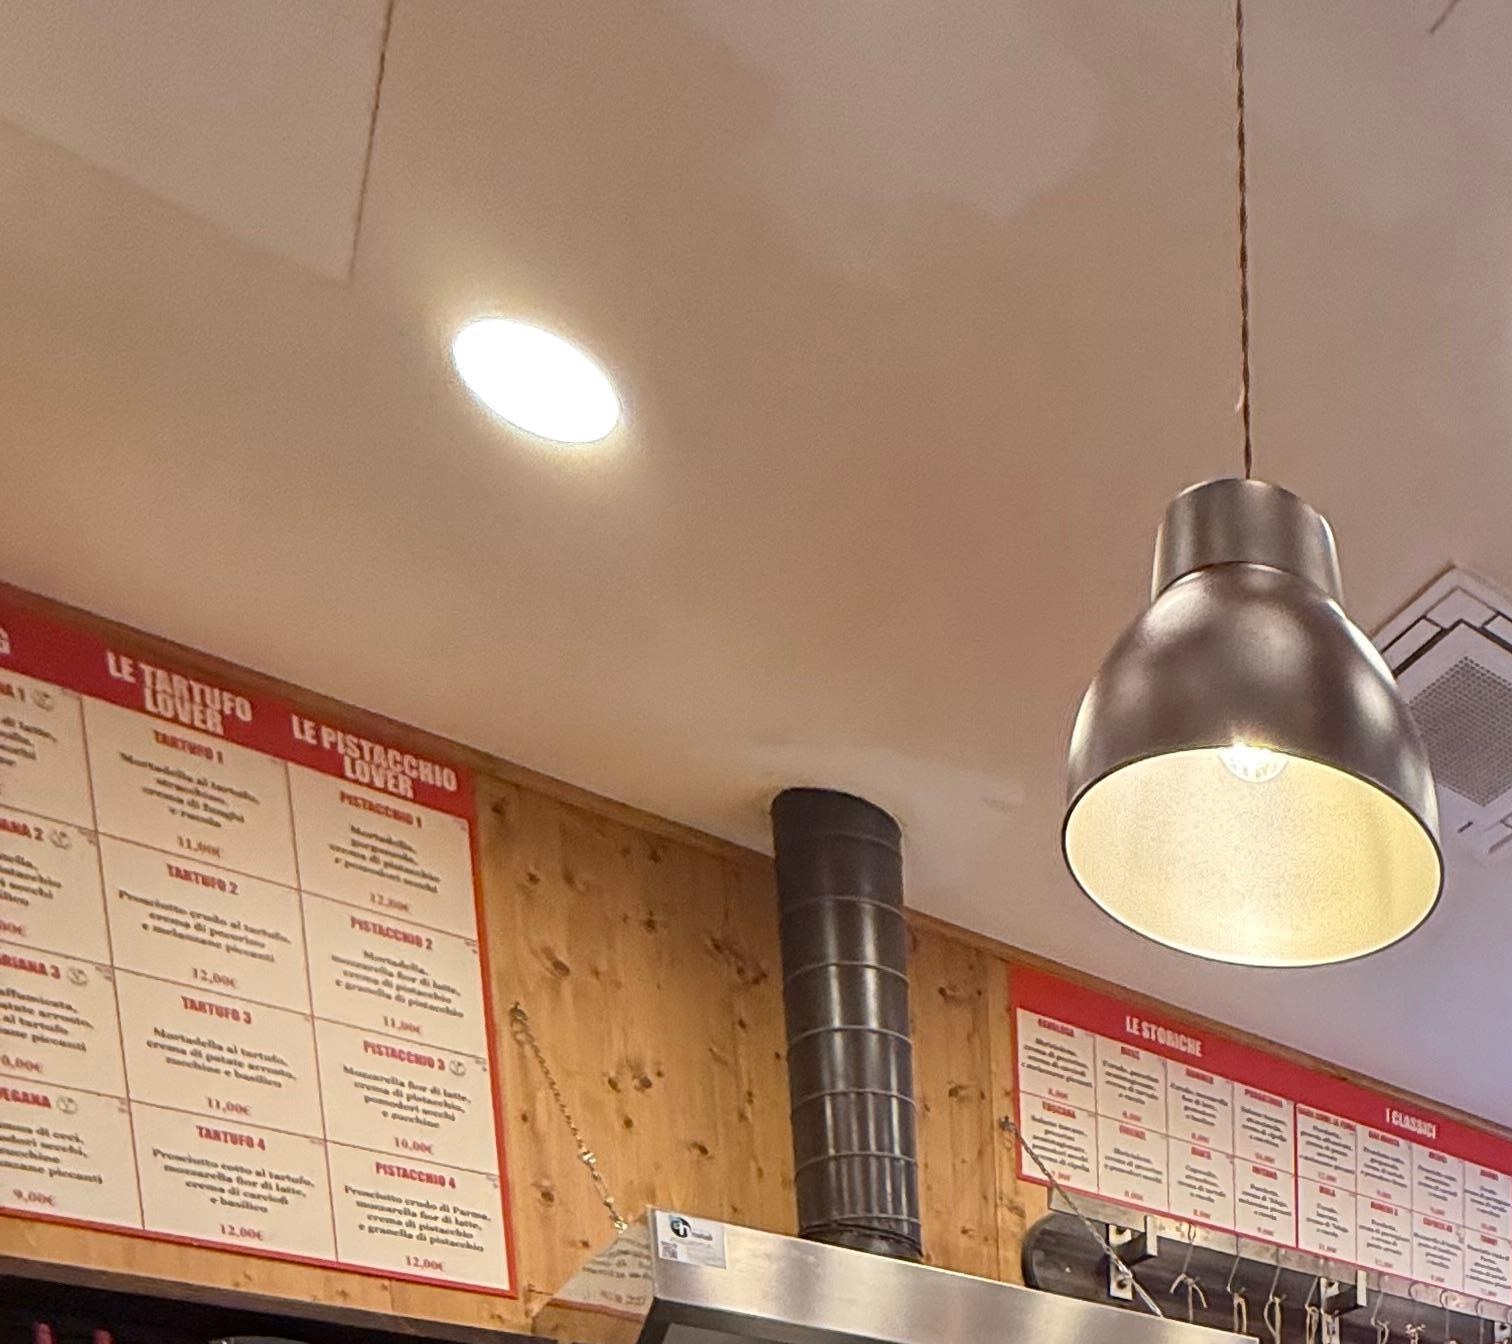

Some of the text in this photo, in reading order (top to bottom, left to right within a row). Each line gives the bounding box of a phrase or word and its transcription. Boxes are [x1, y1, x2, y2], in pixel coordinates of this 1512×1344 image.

[107, 651, 252, 722] LE TARTUFO
[145, 687, 224, 736] LOVER
[292, 714, 457, 791] LE PISTACCHIO
[344, 755, 414, 799] LOVER
[166, 863, 239, 895] TARTUFO 2
[350, 916, 433, 950] PISTACCHIO 2
[181, 996, 252, 1024] TARTUFO 3
[1125, 1015, 1203, 1057] LE STORICHE
[364, 1040, 445, 1071] PISTACCHIO 3
[196, 1125, 266, 1151] TARTUFO 4
[1391, 1110, 1437, 1139] CLASSICI
[376, 1161, 456, 1189] PISTACCHIO 4
